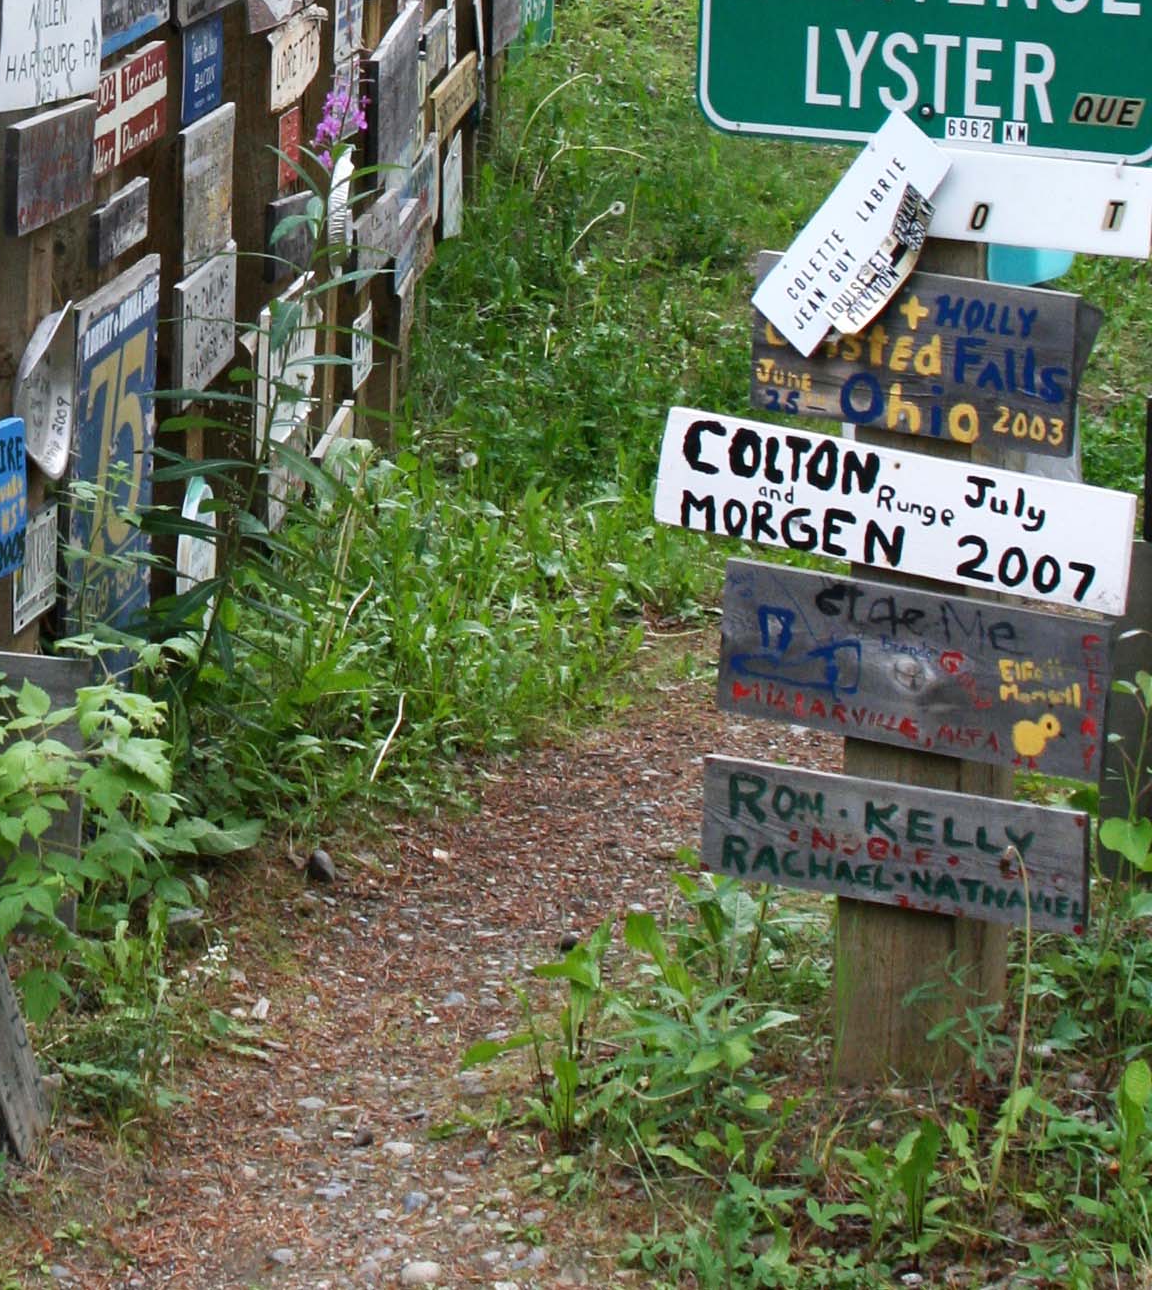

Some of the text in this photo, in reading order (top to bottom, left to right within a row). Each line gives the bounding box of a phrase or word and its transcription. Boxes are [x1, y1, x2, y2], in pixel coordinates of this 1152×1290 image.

[804, 25, 1056, 125] LYSTER
[122, 120, 160, 152] Danmark
[947, 119, 1027, 143] 6962 KM
[1073, 95, 1142, 128] QUE
[786, 157, 906, 302] COLETTE LABRIE
[793, 248, 857, 330] JEAN GUY
[935, 296, 1038, 339] HOLLY
[765, 371, 1065, 445] 25 Ohio 2003
[681, 419, 882, 495] COLTON
[757, 474, 1047, 533] and Runge July
[679, 490, 1098, 604] MORGEN 2007
[864, 800, 1036, 856] KELLY
